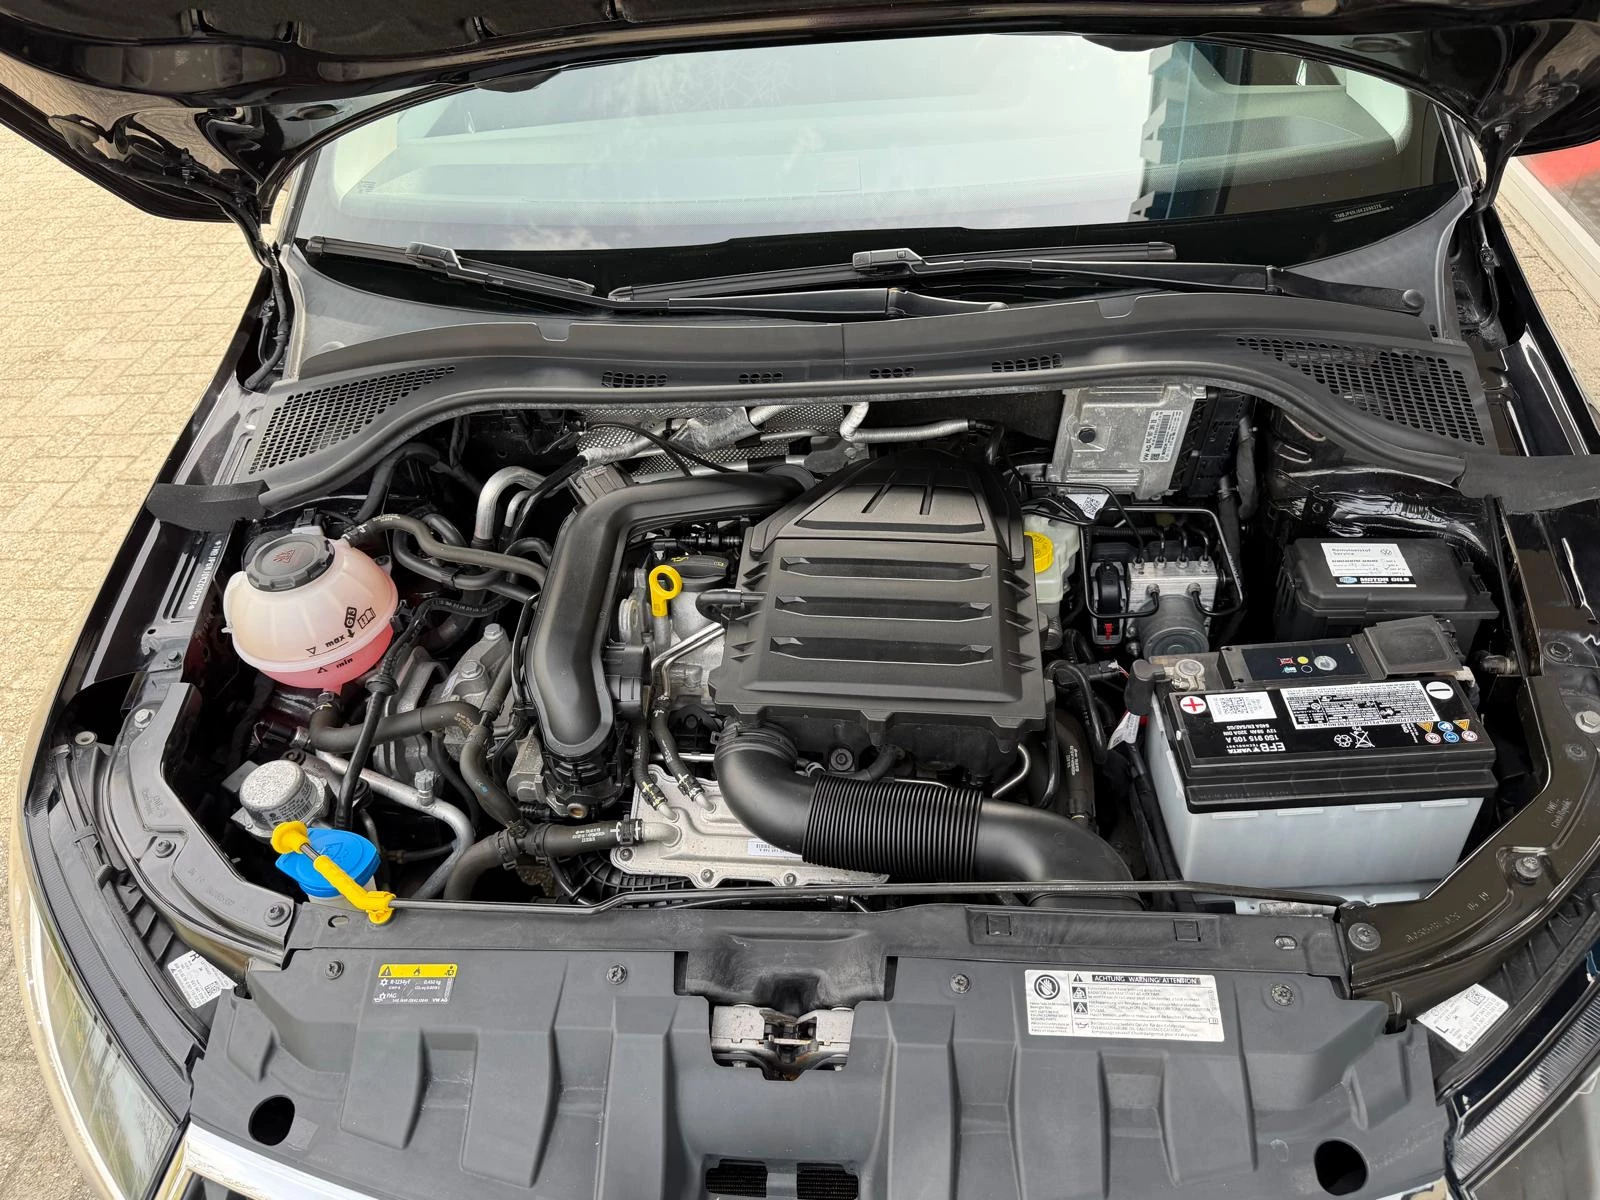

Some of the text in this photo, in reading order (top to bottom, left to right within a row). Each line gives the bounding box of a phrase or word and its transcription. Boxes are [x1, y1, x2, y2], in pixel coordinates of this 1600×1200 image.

[346, 608, 356, 627] G13
[325, 634, 346, 647] max
[336, 658, 354, 668] min
[1232, 736, 1247, 744] 105
[1248, 735, 1264, 743] 915
[1260, 741, 1286, 752] EFB
[1094, 974, 1126, 982] ACHTUNG
